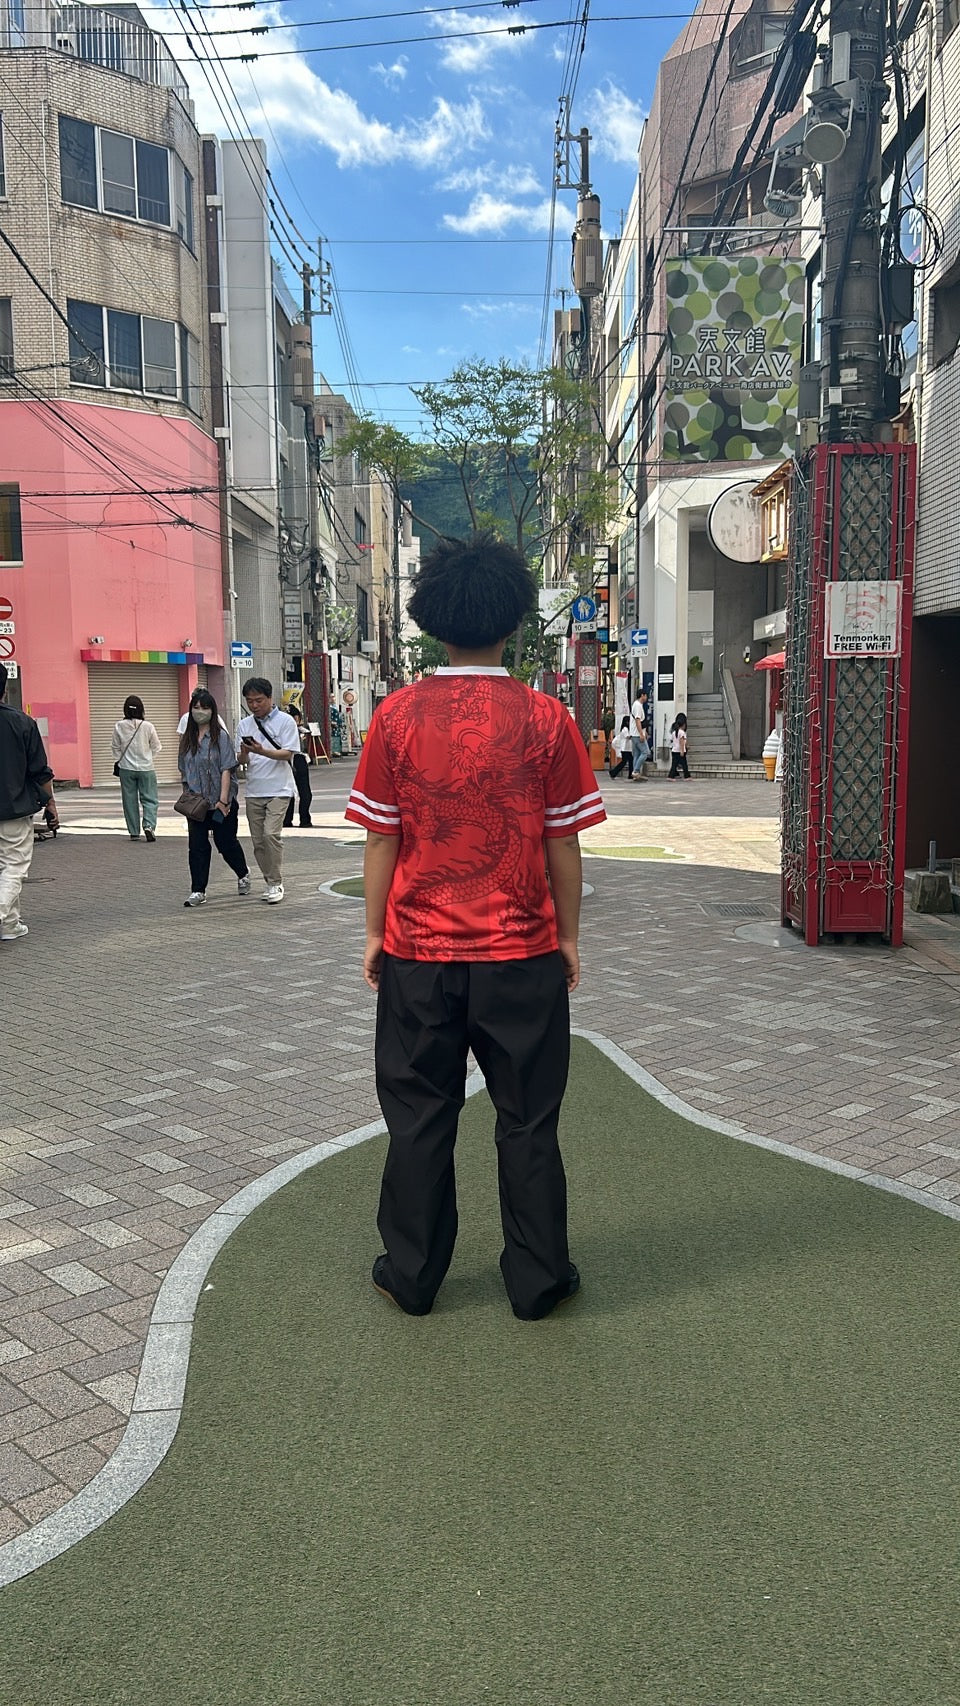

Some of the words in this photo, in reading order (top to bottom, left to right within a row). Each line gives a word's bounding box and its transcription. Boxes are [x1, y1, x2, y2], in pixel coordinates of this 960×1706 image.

[699, 327, 767, 354] 天文館
[670, 354, 745, 377] PARK
[750, 354, 793, 377] AV.
[574, 624, 582, 632] 10
[833, 634, 892, 642] Tenmonkan
[834, 643, 863, 651] FREE
[866, 642, 891, 651] Wi-Fi
[631, 648, 636, 656] 5
[641, 647, 648, 655] 10
[245, 659, 252, 667] 10
